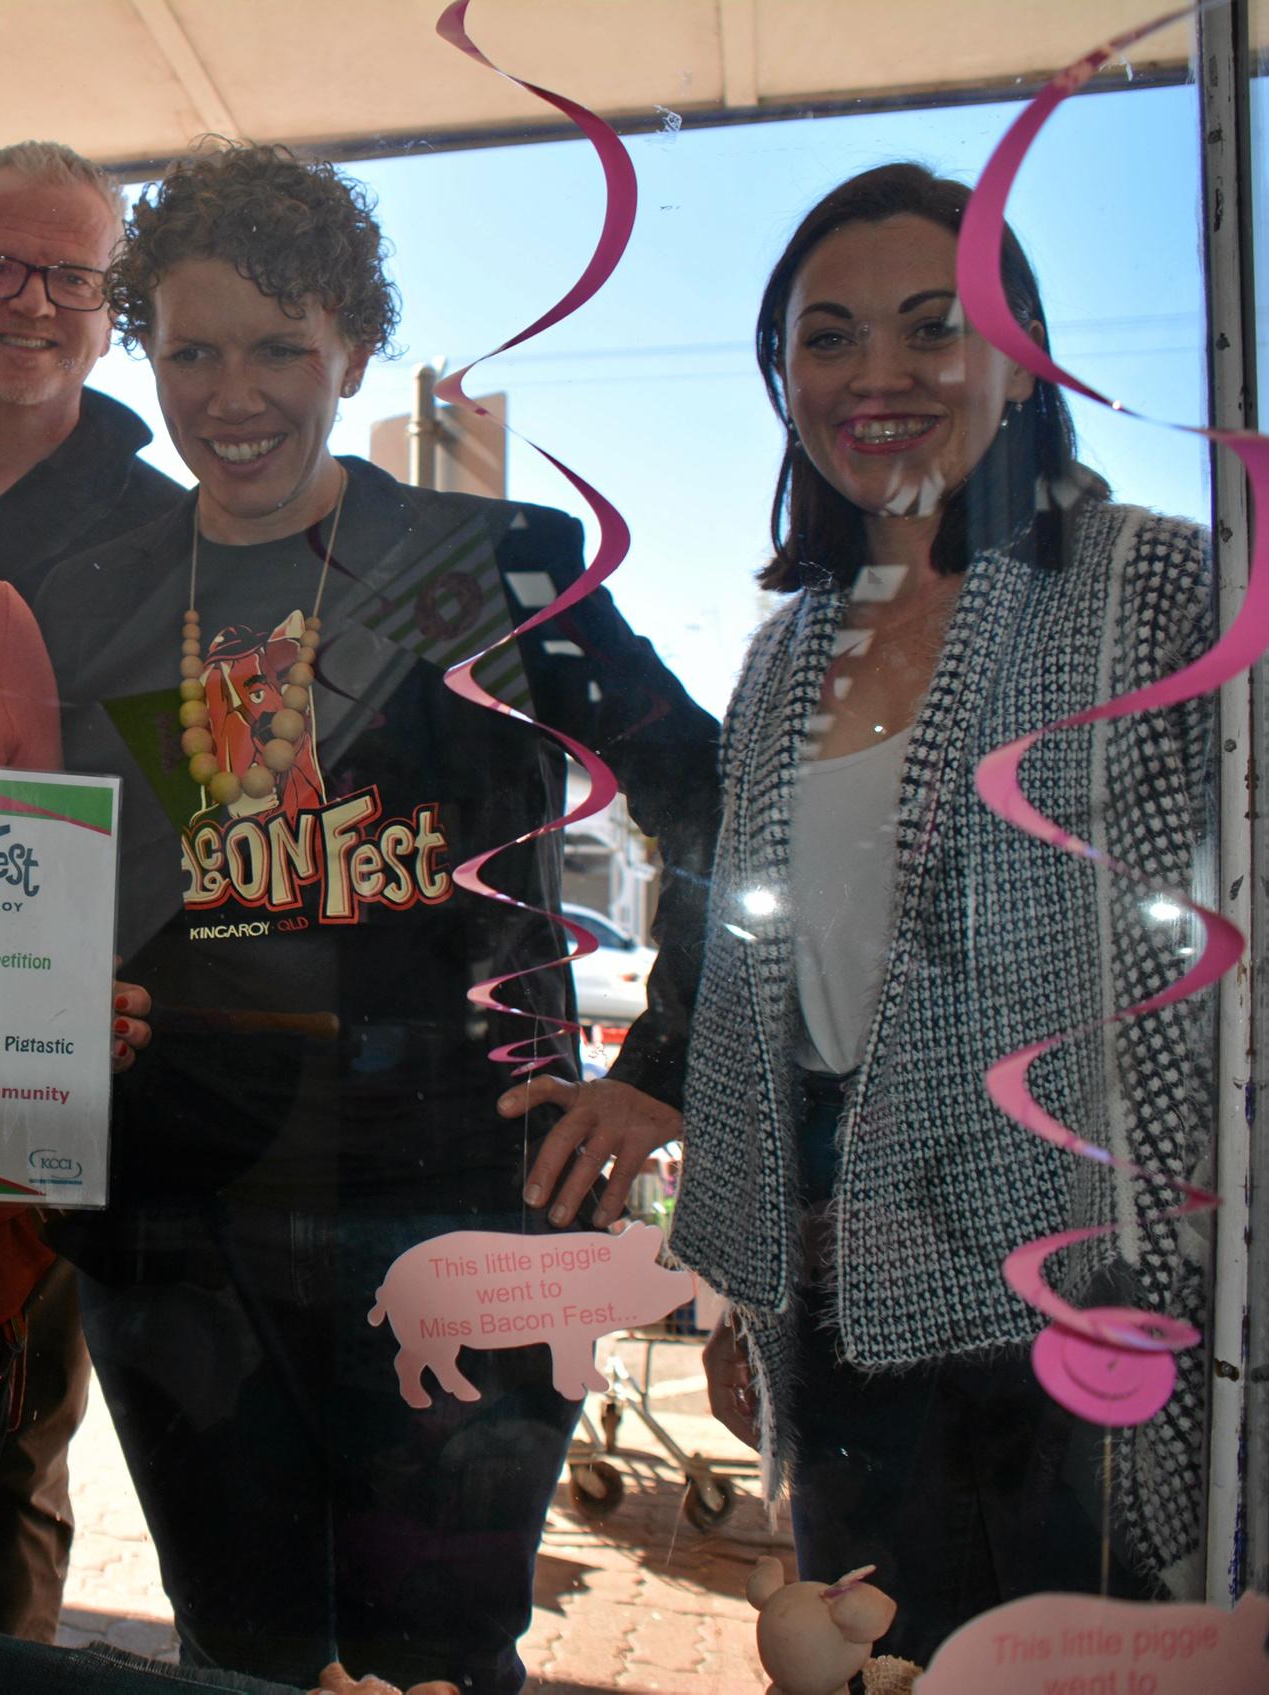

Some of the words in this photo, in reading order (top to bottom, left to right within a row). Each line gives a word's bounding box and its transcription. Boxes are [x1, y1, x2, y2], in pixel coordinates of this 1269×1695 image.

[190, 921, 270, 940] KINGAROY
[277, 916, 309, 932] QLD
[4, 1035, 74, 1055] Pigtastic
[41, 1158, 72, 1170] KCCI
[429, 1256, 478, 1279] This
[486, 1251, 532, 1275] little
[540, 1243, 612, 1274] piggie
[475, 1282, 533, 1304] went
[540, 1278, 562, 1300] to
[419, 1317, 473, 1339] Miss
[481, 1310, 555, 1334] Bacon
[562, 1302, 637, 1328] Fest...
[992, 1631, 1052, 1664] This
[1061, 1626, 1123, 1656] little
[1132, 1619, 1218, 1661] piggie
[1043, 1669, 1118, 1695] went
[1127, 1668, 1157, 1695] to
